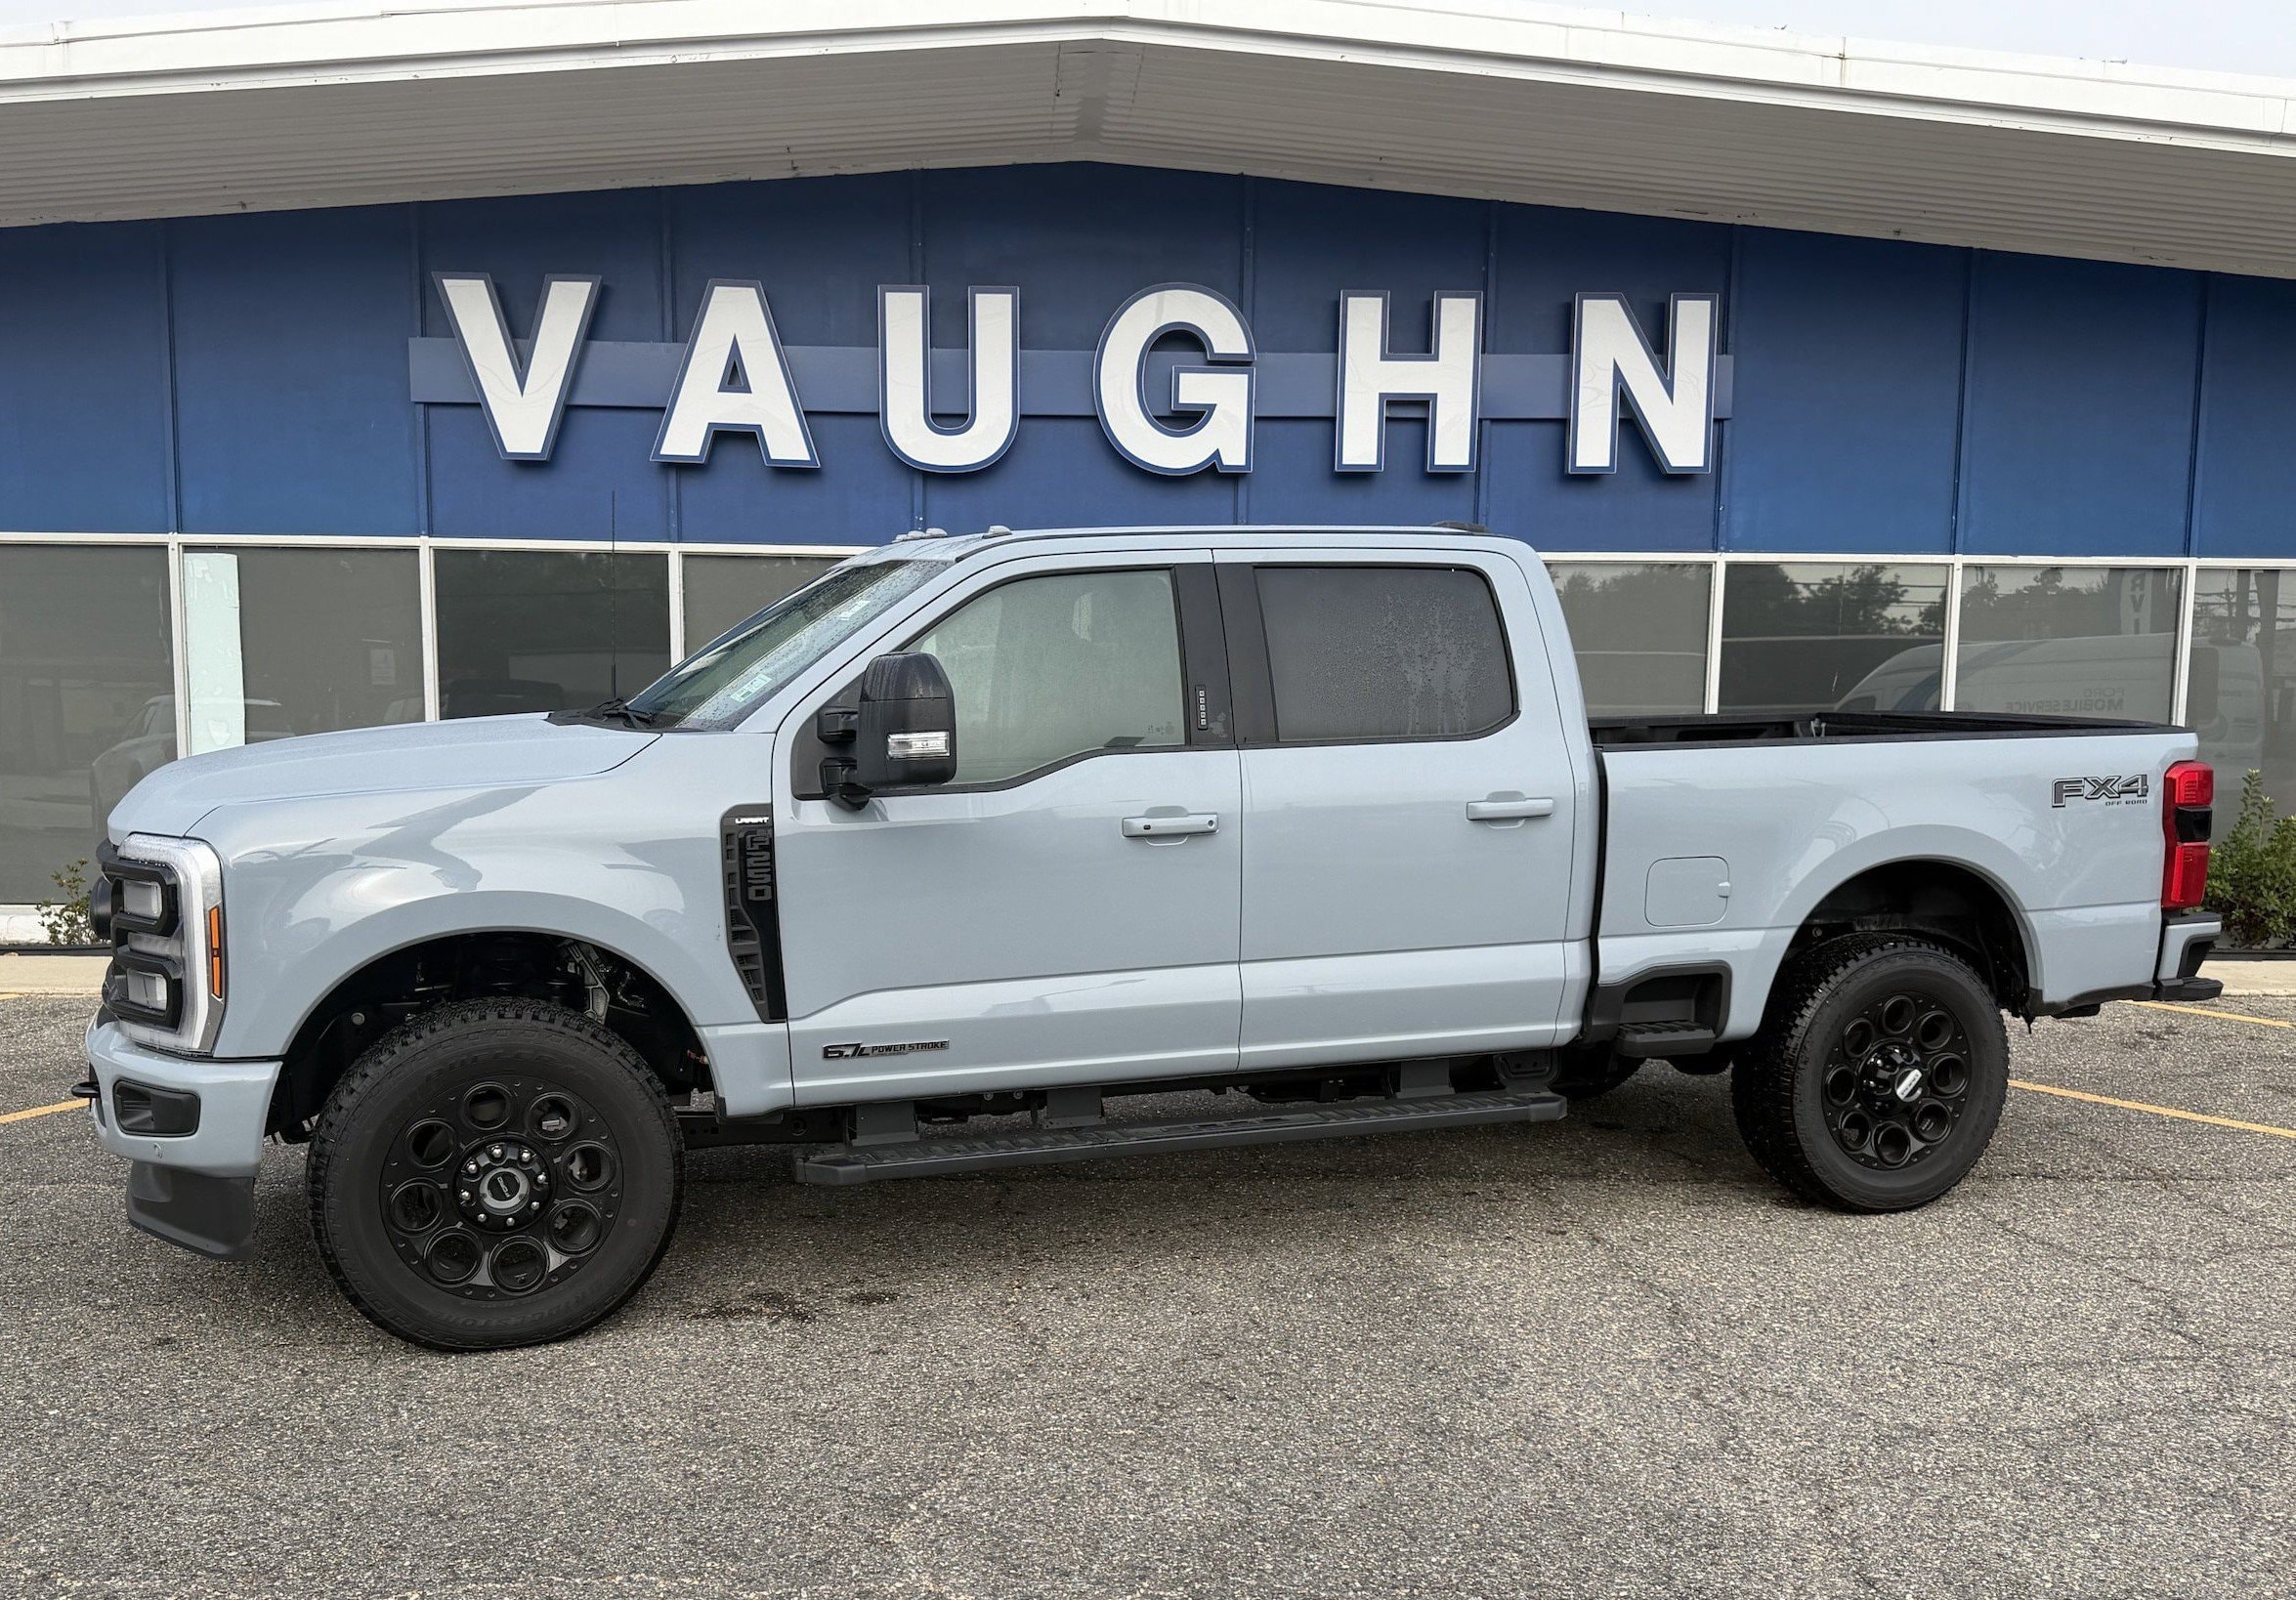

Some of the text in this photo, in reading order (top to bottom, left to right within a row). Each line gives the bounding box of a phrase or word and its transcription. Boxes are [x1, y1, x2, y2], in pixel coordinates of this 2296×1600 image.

[431, 271, 1719, 477] VAUGHN
[2052, 775, 2148, 808] FX4
[823, 1042, 870, 1059] 6.7L
[872, 1043, 907, 1054] POWER
[909, 1040, 947, 1051] STROKE
